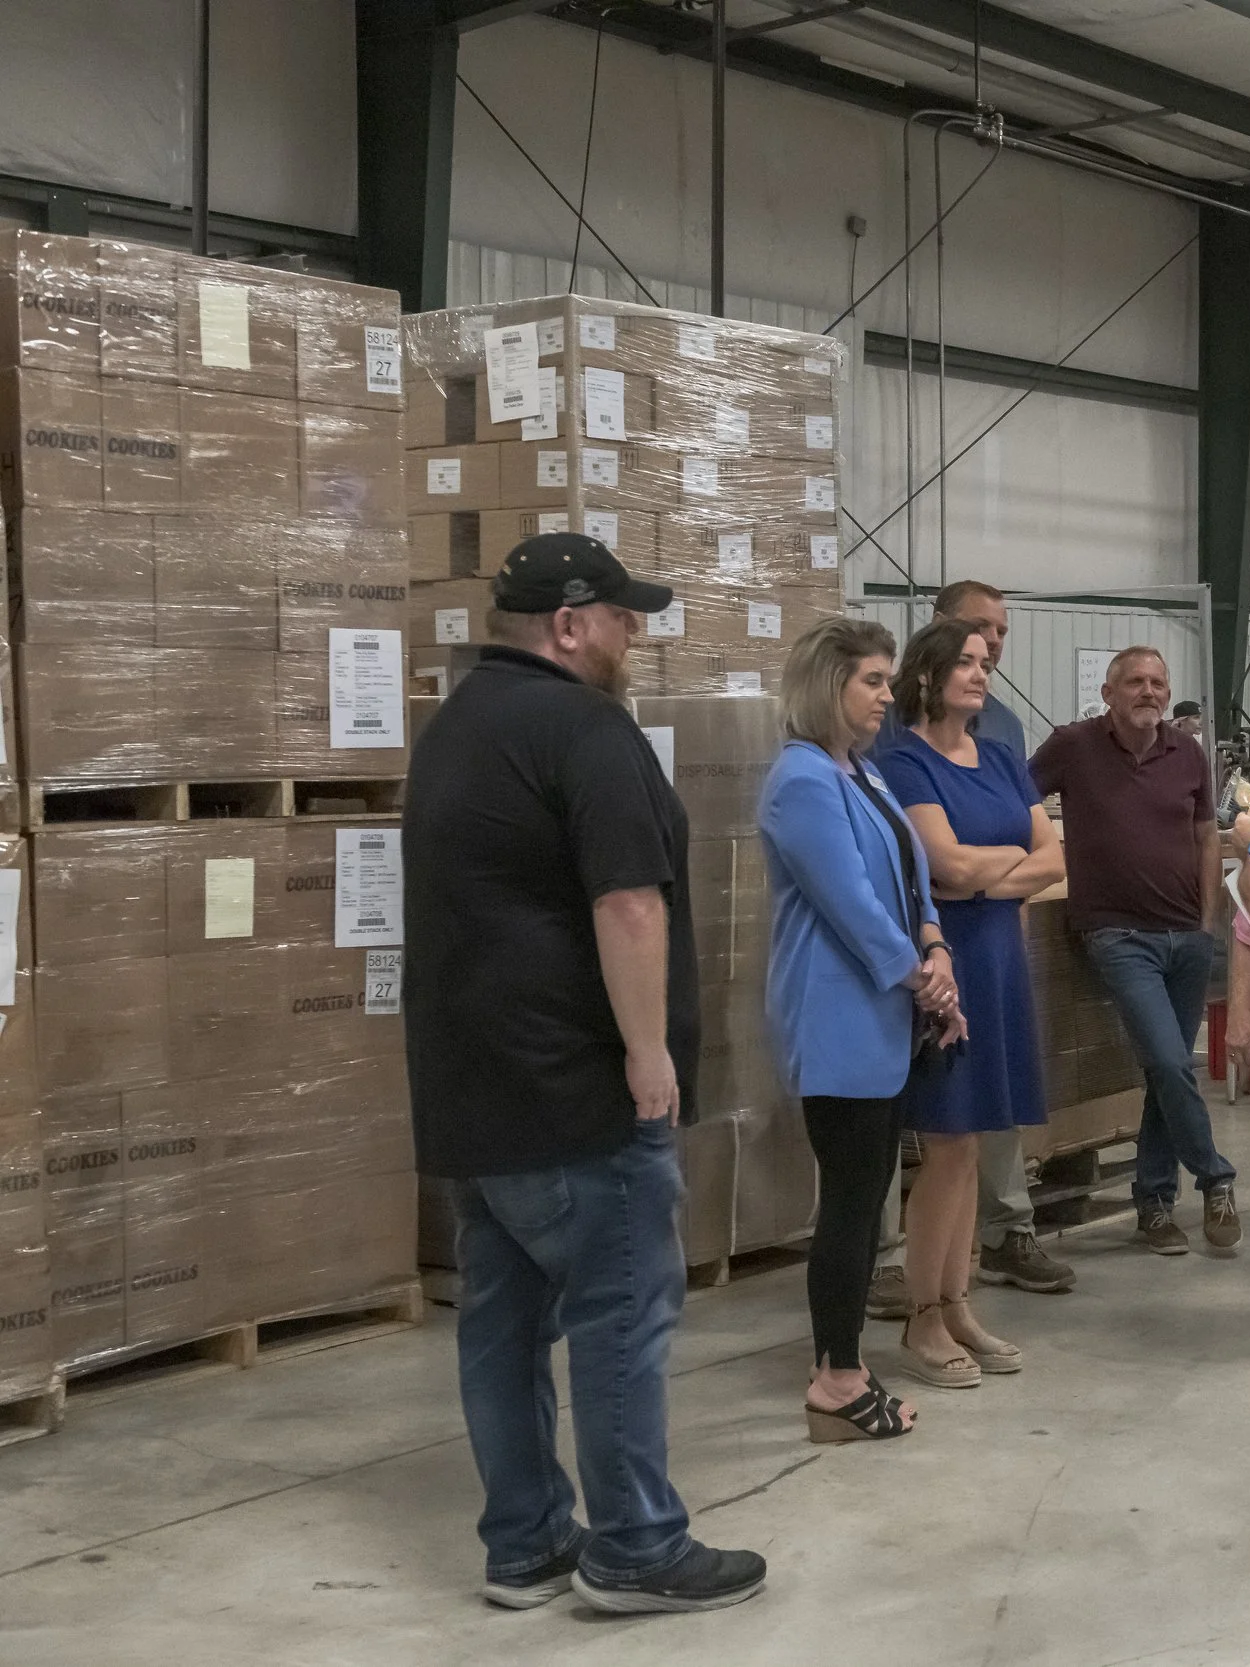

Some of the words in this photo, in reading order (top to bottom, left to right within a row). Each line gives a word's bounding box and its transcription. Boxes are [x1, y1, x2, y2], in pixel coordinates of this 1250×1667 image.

[367, 331, 398, 346] 58124
[376, 360, 391, 376] 27
[26, 429, 98, 451] COOKIES
[108, 437, 176, 459] COOKIES
[348, 584, 405, 601] COOKIES
[677, 764, 744, 778] DISPOSABLE
[368, 955, 401, 968] 58124
[375, 983, 392, 998] 27
[293, 995, 352, 1013] COOKIES
[46, 1148, 119, 1175] COOKIES
[128, 1137, 197, 1161] COOKIES
